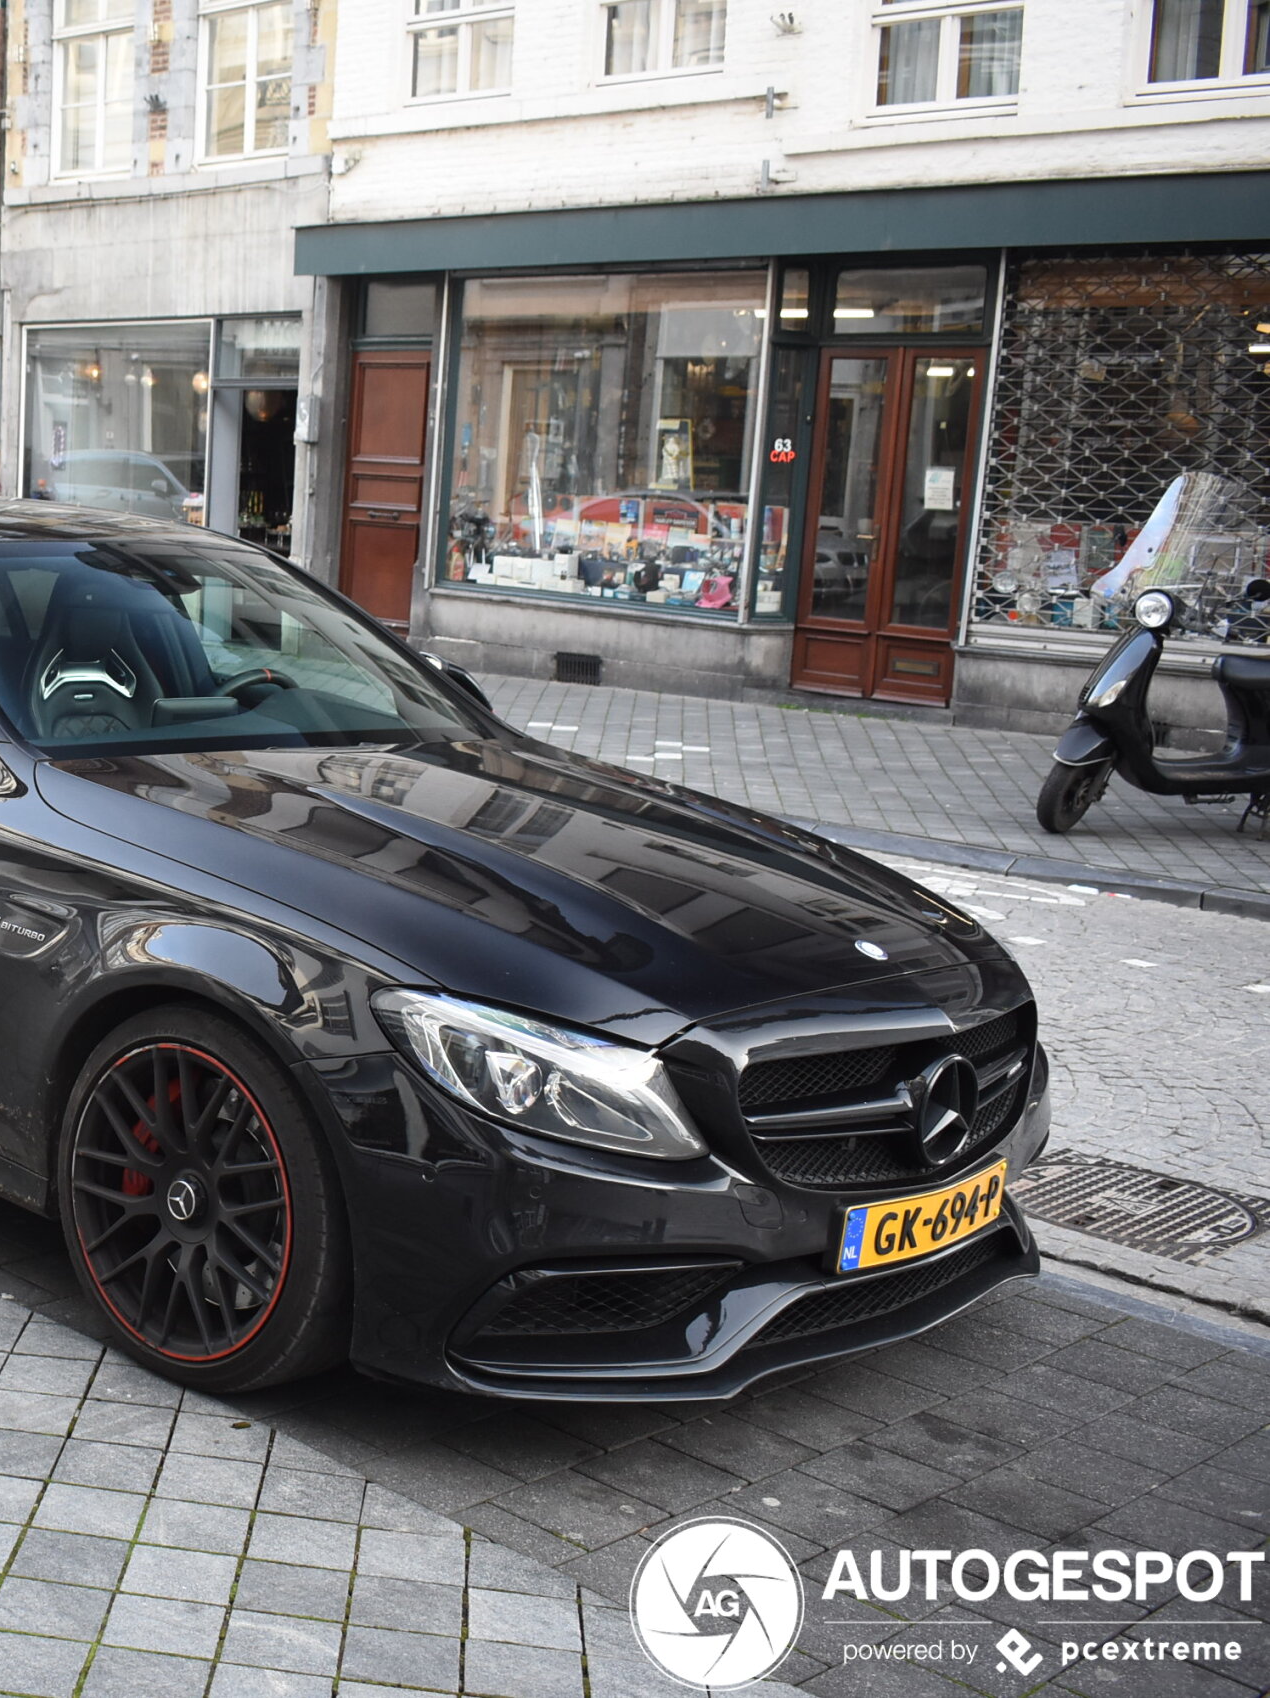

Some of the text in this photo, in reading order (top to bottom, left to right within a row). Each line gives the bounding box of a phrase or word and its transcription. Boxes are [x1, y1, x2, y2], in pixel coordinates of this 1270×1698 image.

[774, 438, 792, 452] 63
[769, 449, 796, 463] CAP
[0, 920, 46, 942] BITURBO
[874, 1174, 1001, 1256] GK-694-P
[842, 1246, 858, 1260] NL
